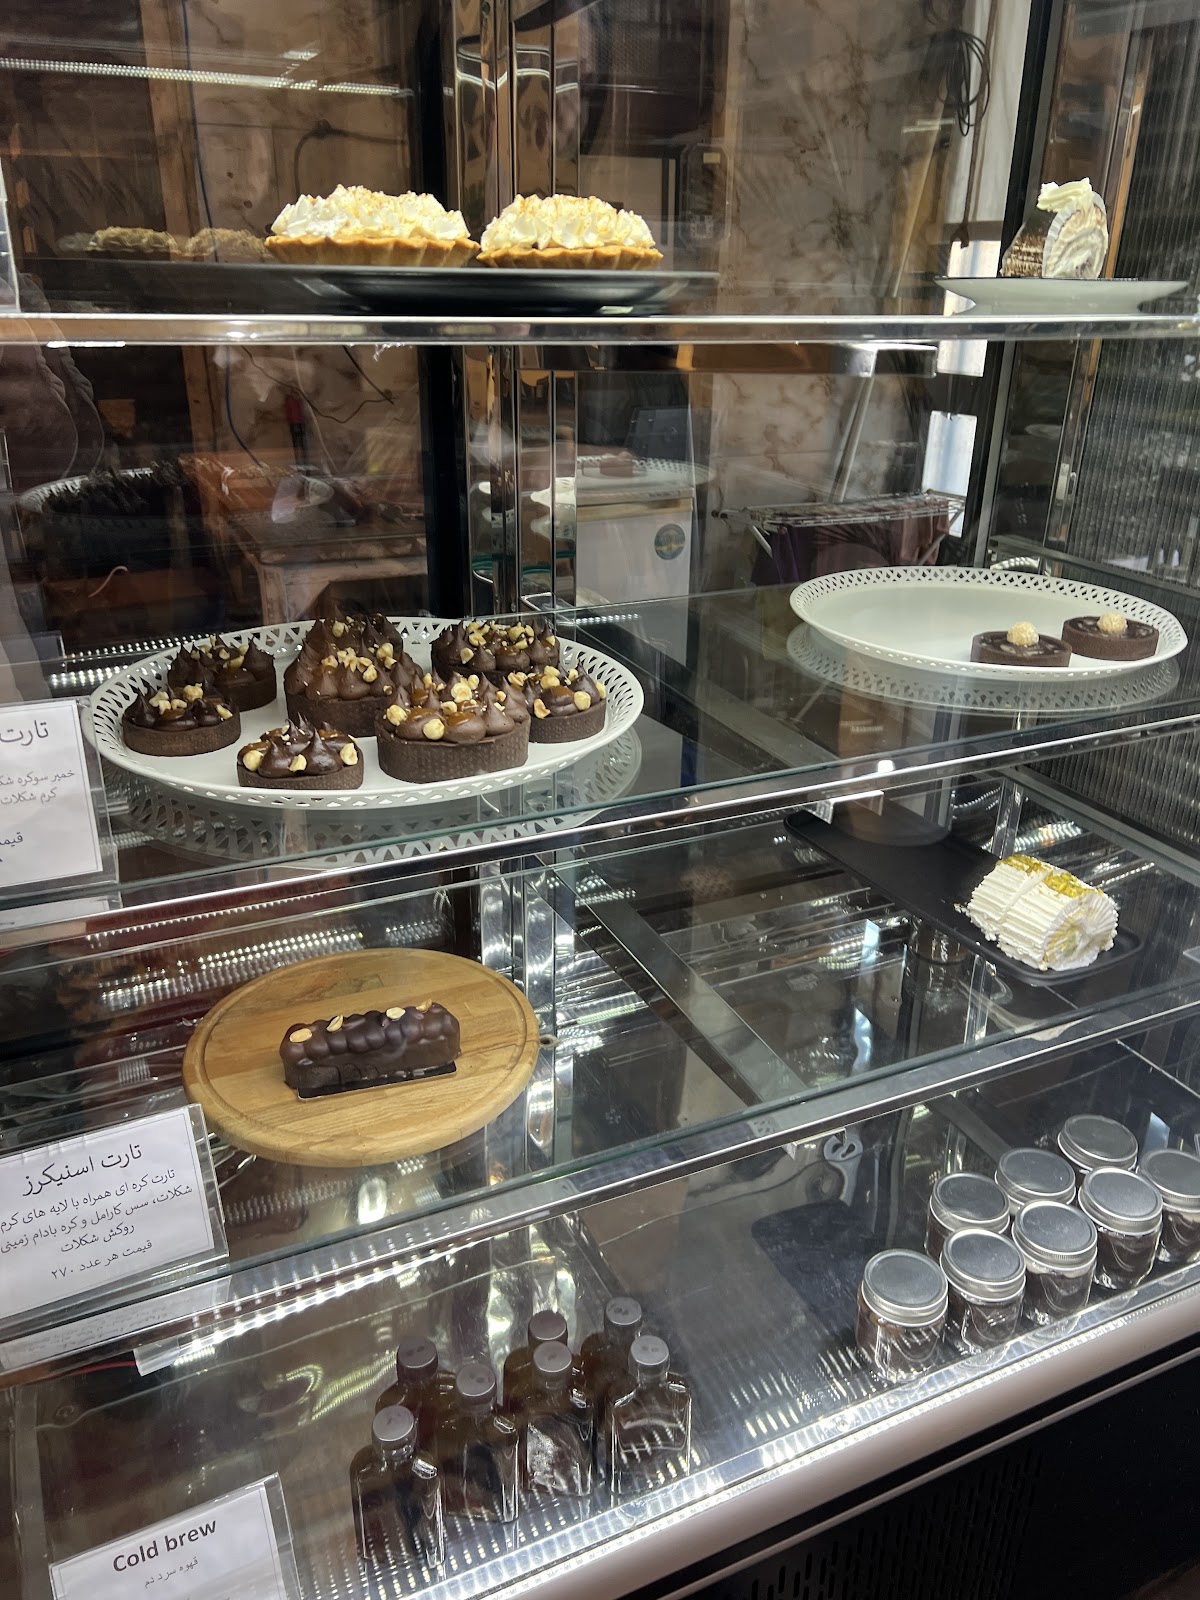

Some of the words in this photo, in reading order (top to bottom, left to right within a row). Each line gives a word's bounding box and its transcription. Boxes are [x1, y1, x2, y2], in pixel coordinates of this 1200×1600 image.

[0, 720, 49, 746] تارت
[51, 770, 75, 783] خمیر
[1, 791, 37, 805] شکلات
[40, 787, 57, 804] کرم
[0, 831, 23, 847] قیم
[101, 1144, 142, 1168] تارت
[22, 1156, 95, 1196] اسنیکرز
[132, 1174, 149, 1192] کره
[151, 1169, 175, 1184] تارت
[115, 1182, 129, 1196] ای
[71, 1198, 80, 1210] با
[82, 1189, 112, 1207] همراه
[22, 1208, 46, 1224] های
[50, 1199, 68, 1216] لایه
[90, 1203, 122, 1225] کارامل
[125, 1201, 149, 1216] سس
[0, 1211, 19, 1234] کرم
[61, 1215, 78, 1235] کره
[80, 1219, 87, 1229] و
[32, 1225, 57, 1245] بادام
[103, 1222, 135, 1242] روکش
[0, 1234, 29, 1253] زمینی
[60, 1233, 99, 1253] شکلات
[122, 1240, 153, 1257] قیمت
[79, 1258, 102, 1272] عدد
[104, 1253, 119, 1267] هر
[112, 1540, 159, 1572] Cold
[164, 1520, 217, 1552] brew
